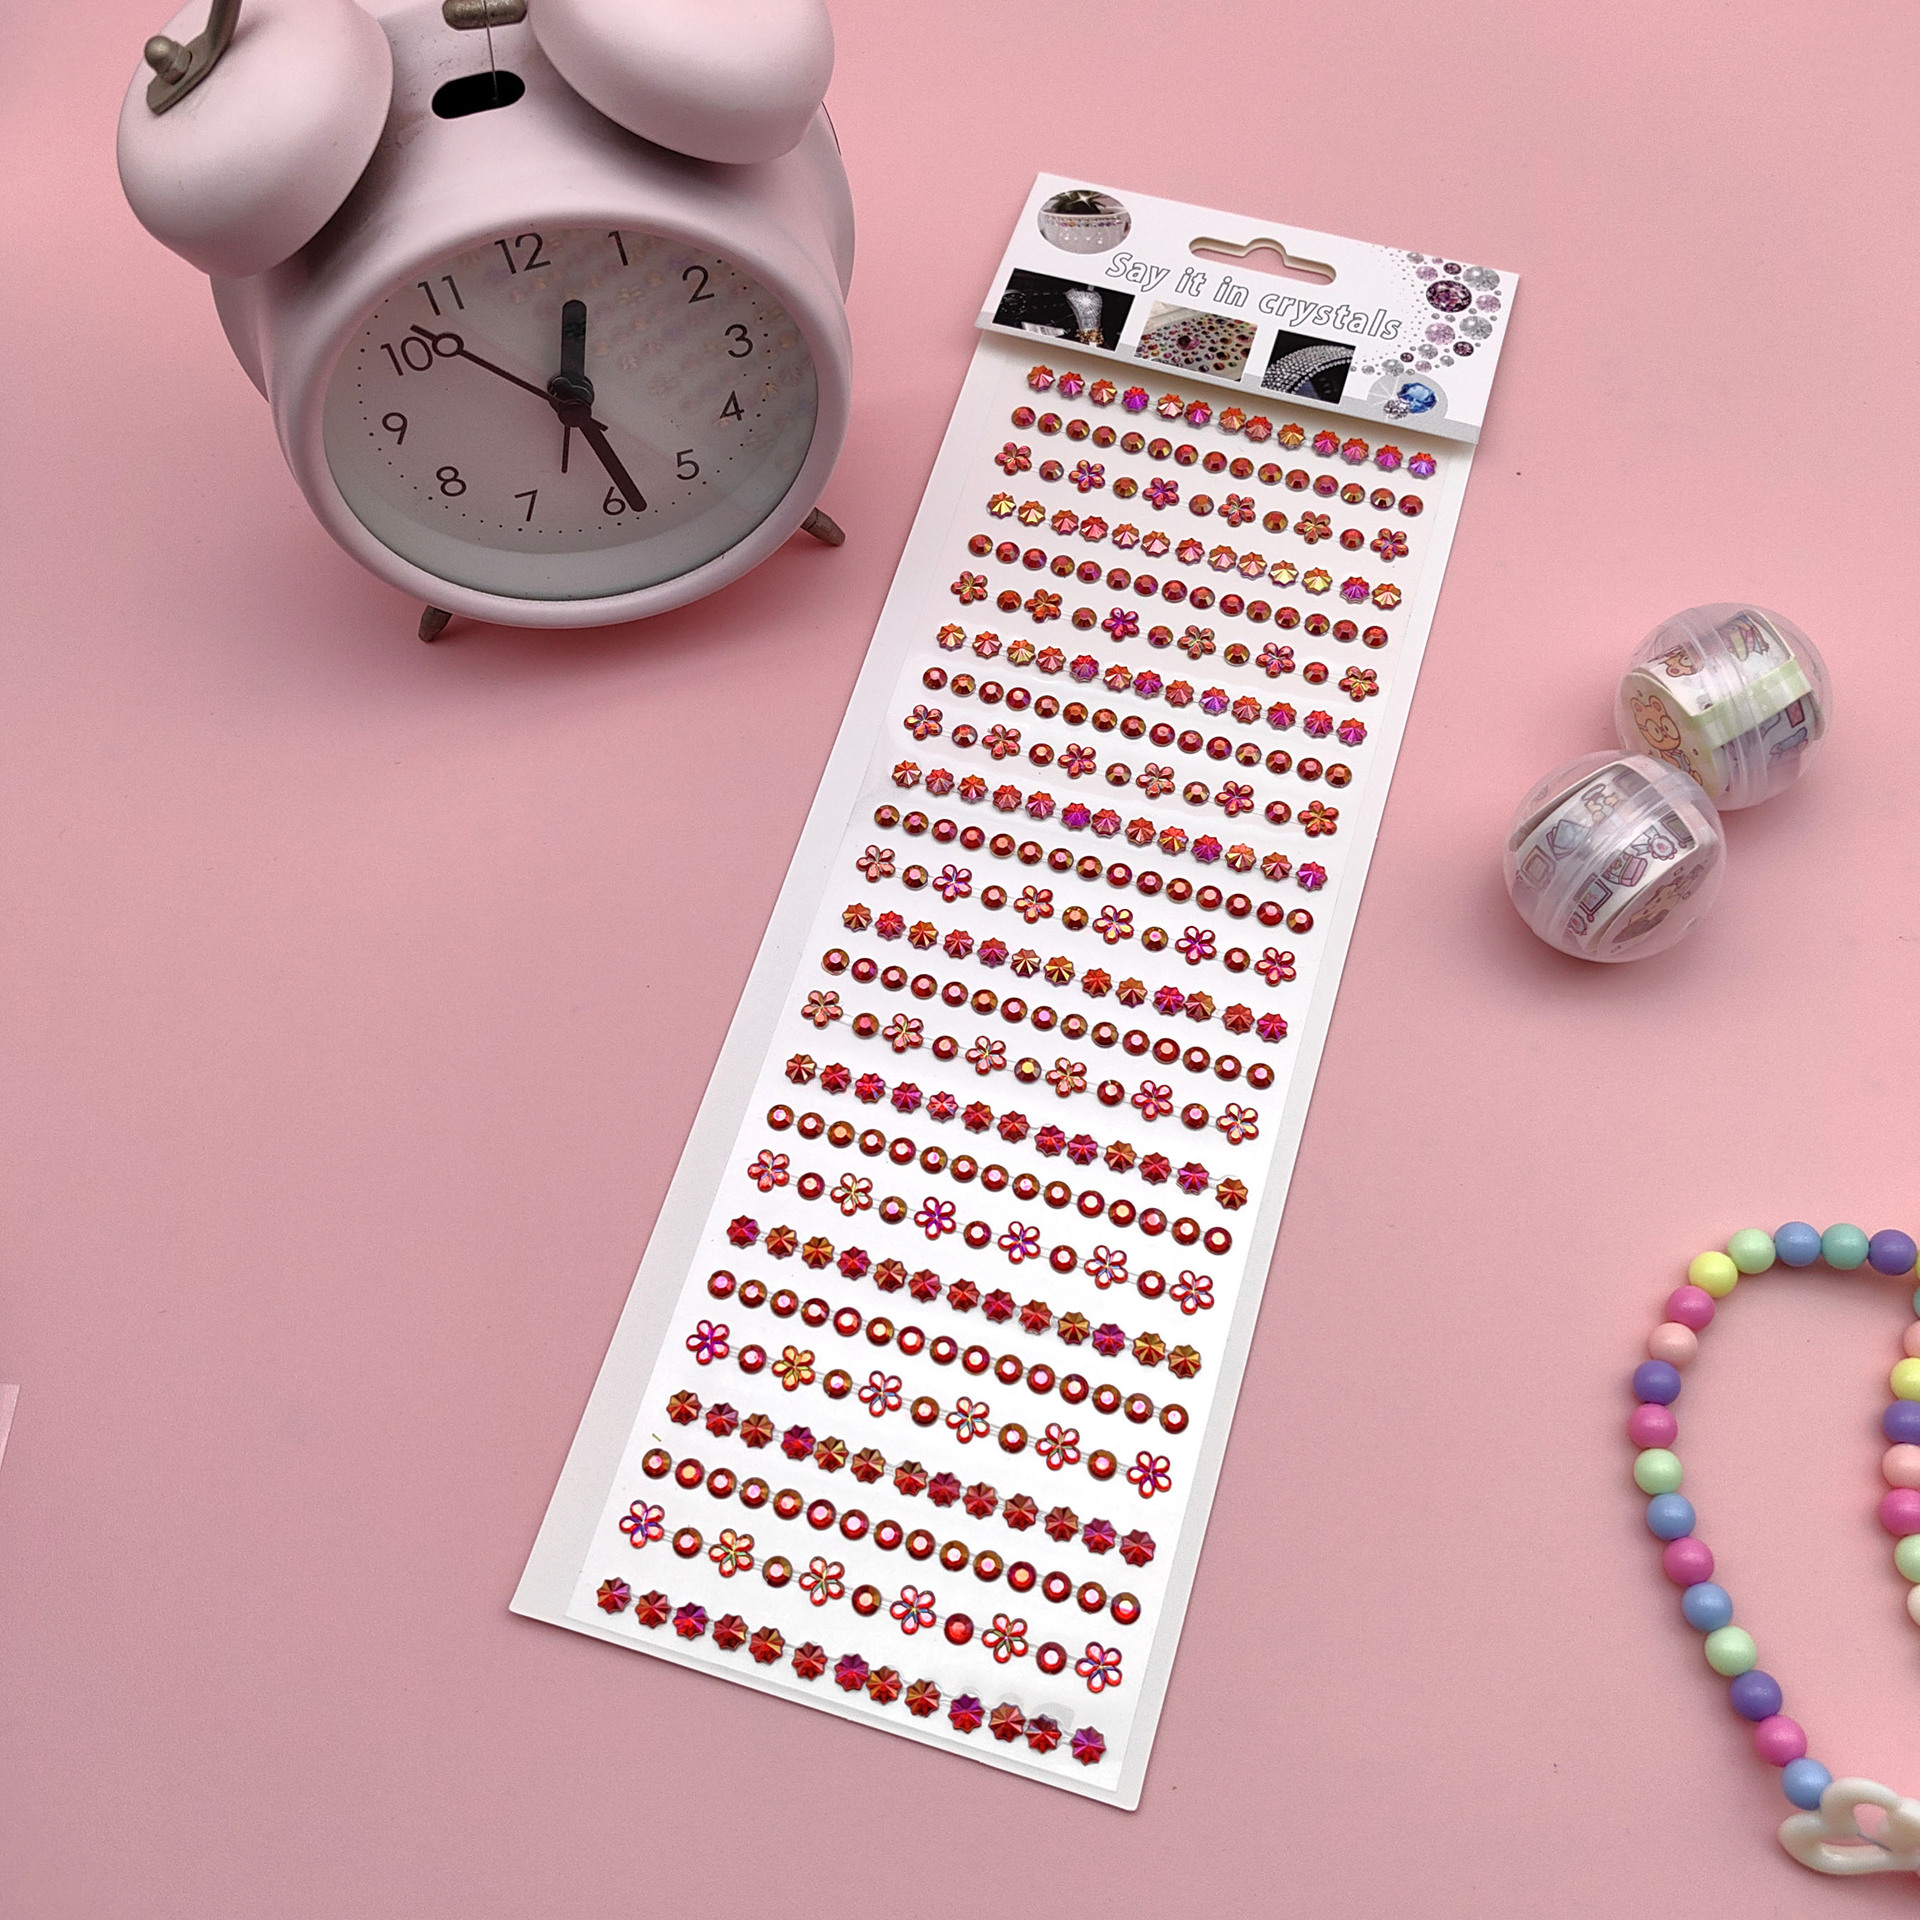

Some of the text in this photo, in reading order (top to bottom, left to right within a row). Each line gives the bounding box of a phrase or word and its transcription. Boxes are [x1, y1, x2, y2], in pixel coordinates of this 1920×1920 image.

[494, 232, 551, 274] 12
[608, 231, 629, 266] 1
[417, 275, 465, 316] 11
[682, 265, 715, 303] 2
[1105, 252, 1402, 341] Say it in crystals
[381, 336, 434, 376] 10
[724, 324, 753, 358] 3
[719, 391, 744, 421] 4
[382, 412, 408, 445] 9
[436, 466, 467, 497] 8
[676, 449, 700, 480] 5
[514, 490, 538, 522] 7
[602, 486, 626, 516] 6
